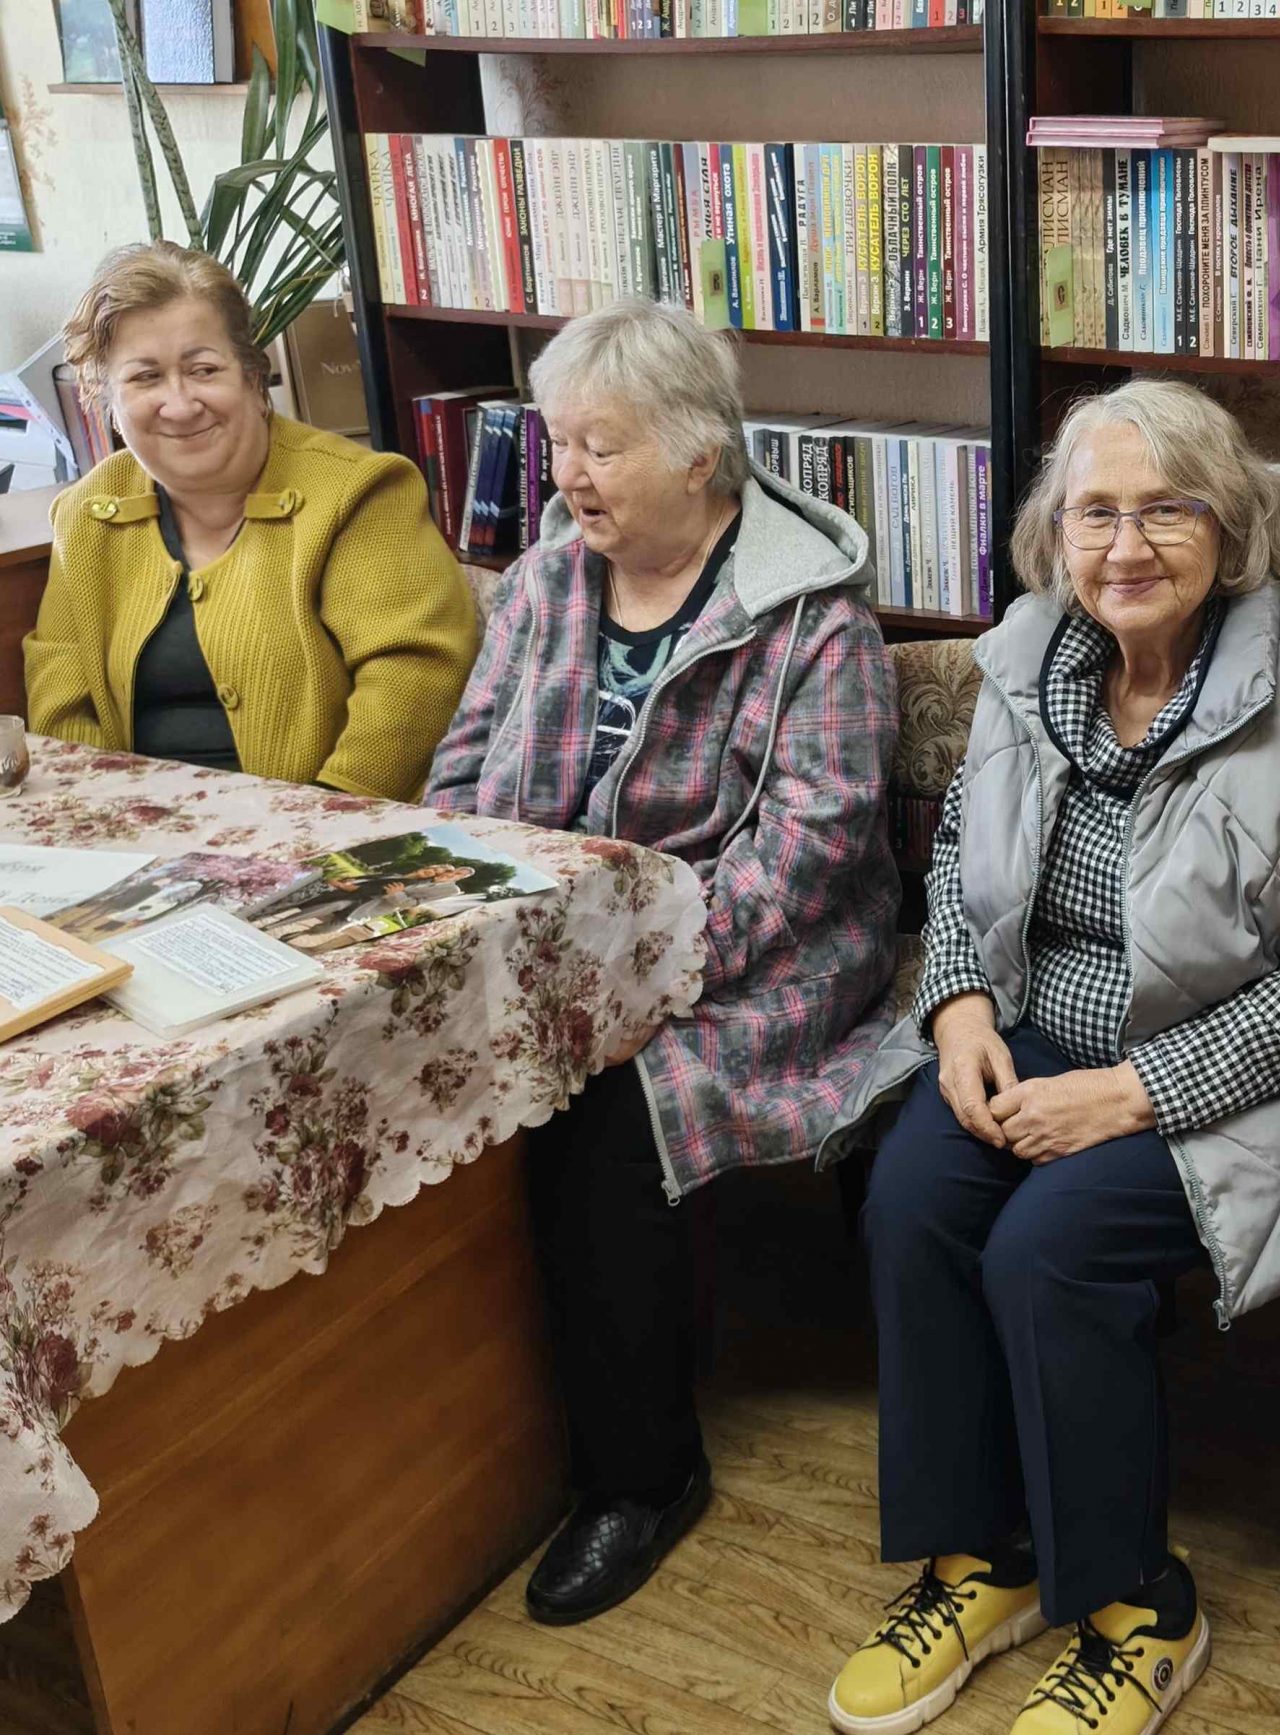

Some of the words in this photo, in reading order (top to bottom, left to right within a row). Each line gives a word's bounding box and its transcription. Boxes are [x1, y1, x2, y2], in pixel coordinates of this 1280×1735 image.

[1254, 4, 1261, 16] 3
[1269, 4, 1277, 16] 4
[405, 152, 413, 177] ЛЕТА
[514, 148, 525, 194] РАЗВЕДКИ
[650, 151, 662, 202] Маргарита
[722, 163, 732, 196] охота
[856, 155, 866, 199] ВОРОН
[868, 154, 879, 199] ВОРОН
[886, 162, 897, 193] ПОЛК
[916, 165, 924, 196] остров
[930, 169, 938, 200] остров
[944, 168, 952, 198] остров
[1118, 159, 1130, 207] ТУМАНЕ
[1201, 158, 1209, 211] ПЛИНТУСОМ
[408, 181, 418, 221] МНОГАЯ
[797, 180, 806, 226] РАДУГА
[844, 160, 853, 225] ДЕВОЧКИ
[900, 177, 909, 196] ЛЕТ
[977, 156, 987, 216] Трясогузки
[1229, 169, 1238, 227] ДЫХАНИЕ
[518, 196, 528, 236] ЗАКОНЫ
[655, 213, 664, 248] Мастер
[725, 203, 735, 244] Утиная
[886, 197, 898, 261] ОБЛАЧНЫЙ
[901, 202, 909, 222] СТО
[916, 198, 924, 258] Таинственный
[929, 201, 937, 261] Таинственный
[943, 199, 952, 259] Таинственный
[1201, 212, 1209, 224] ЗА
[846, 231, 854, 255] ТРИ
[857, 204, 868, 271] КУСАТЕЛЬ
[869, 204, 880, 270] КУСАТЕЛЬ
[901, 227, 910, 257] ЧЕРЕЗ
[977, 219, 985, 253] Армия
[1119, 227, 1129, 278] ЧЕЛОВЕК
[1201, 226, 1209, 249] МЕНЯ
[1229, 234, 1238, 279] ВТОРОЕ
[730, 257, 739, 297] Вампилов
[917, 269, 925, 291] Верн
[931, 272, 939, 292] Верн
[945, 270, 953, 291] Верн
[1202, 251, 1211, 308] ПОХОРОНИТЕ
[978, 465, 987, 501] марте
[978, 512, 988, 555] Фиалки
